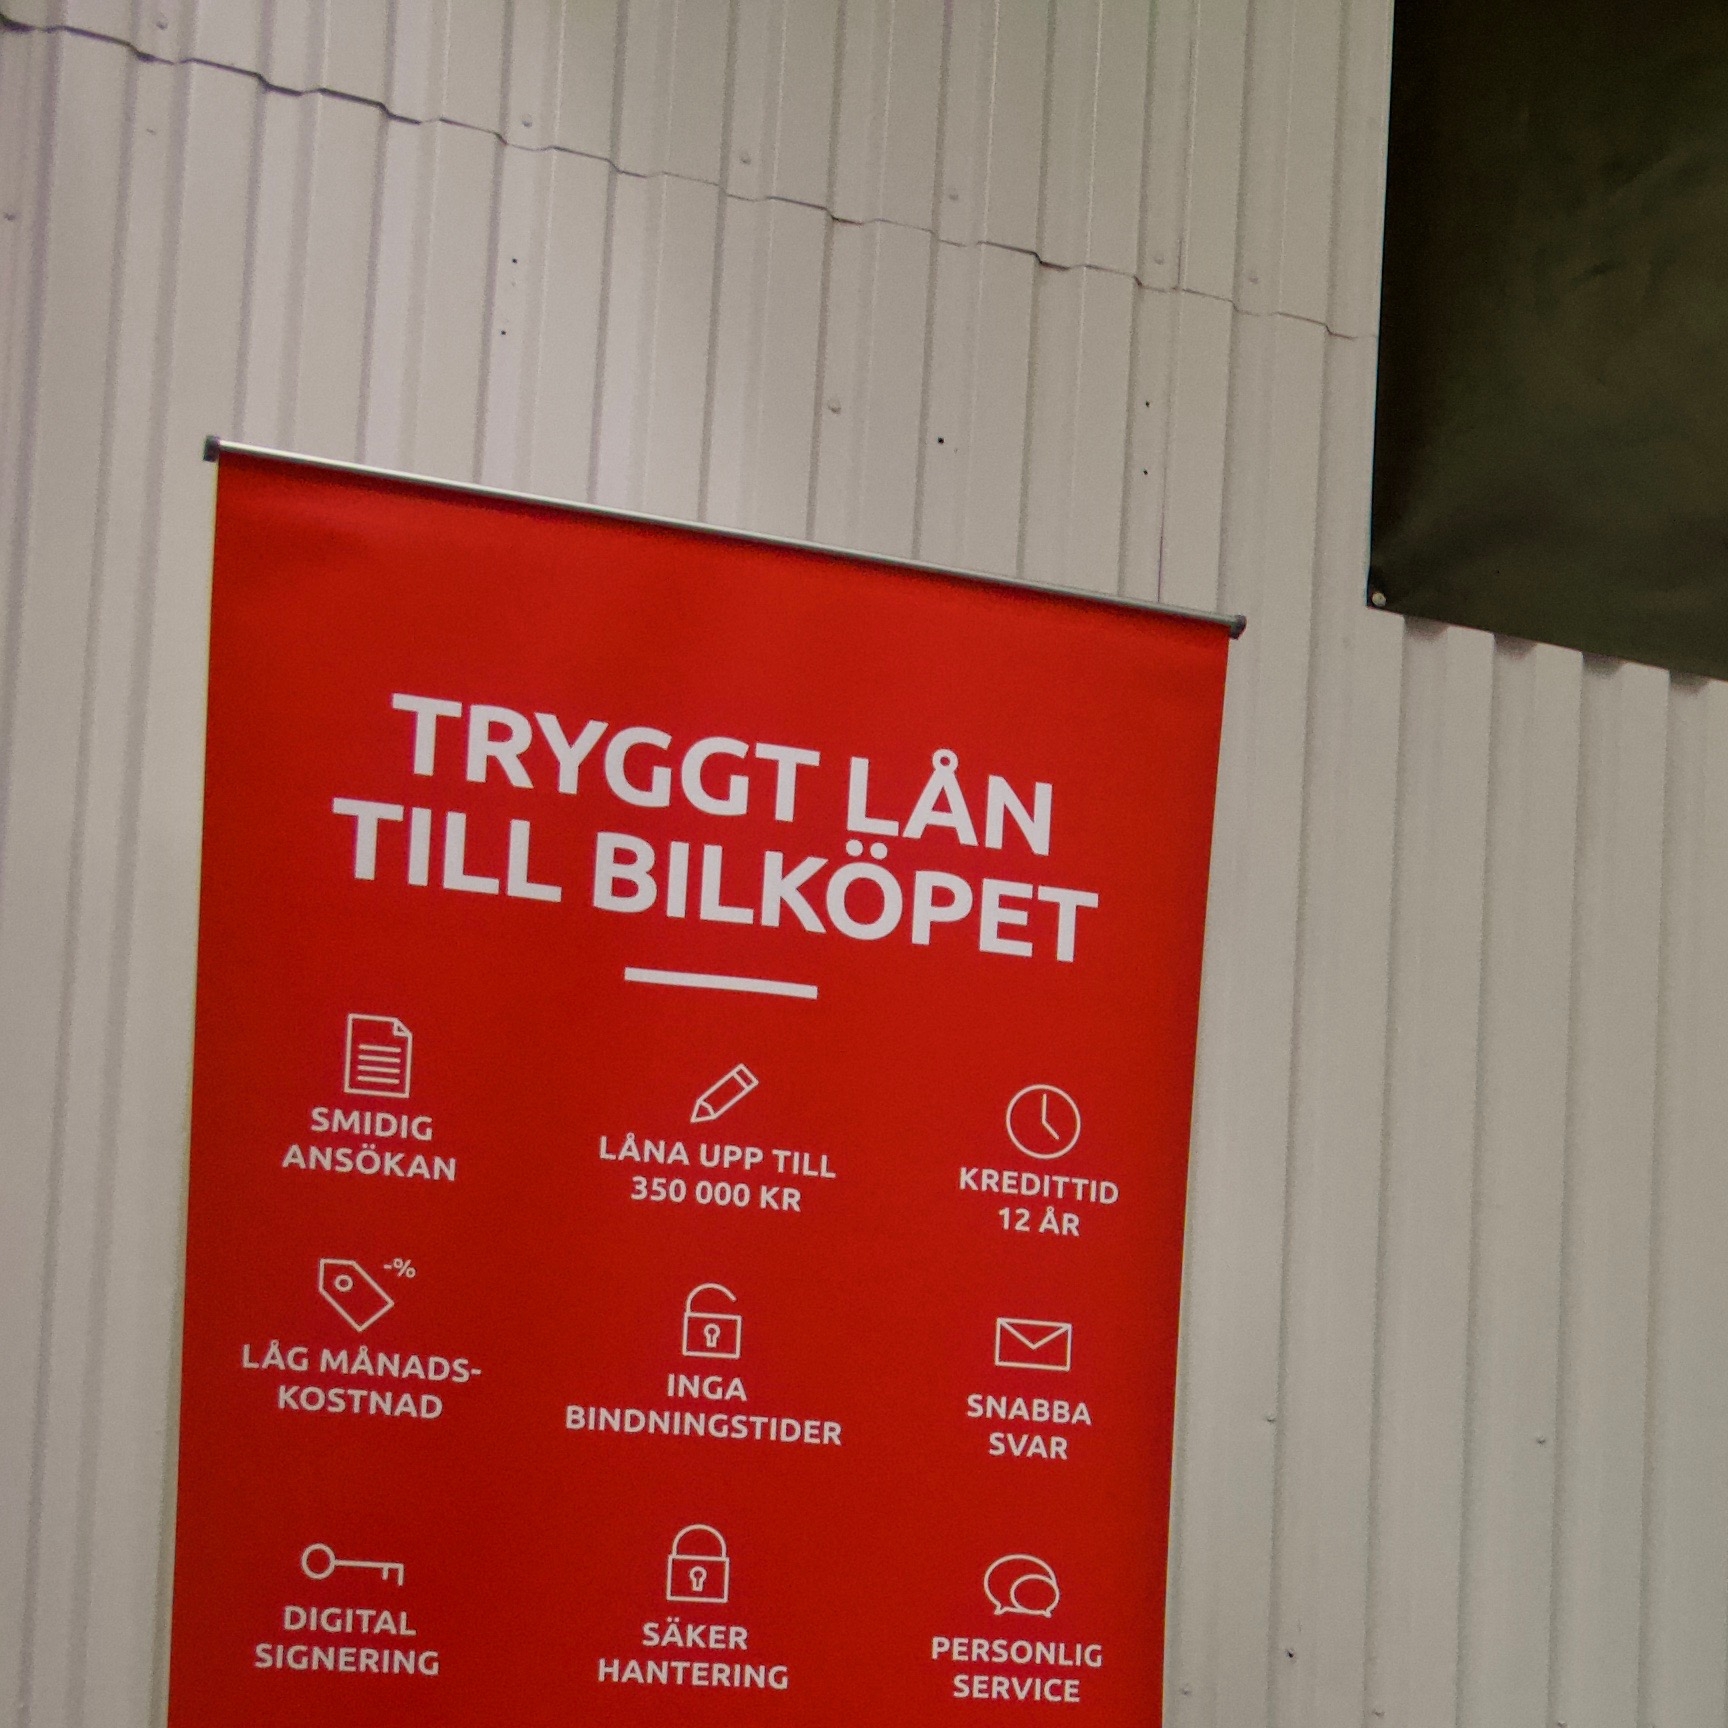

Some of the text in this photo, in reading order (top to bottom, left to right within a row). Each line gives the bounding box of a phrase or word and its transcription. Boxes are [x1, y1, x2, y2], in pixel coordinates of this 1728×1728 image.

[390, 692, 1053, 856] TRYGGT LÅN
[332, 797, 1099, 963] TILL BILKÖPET
[310, 1106, 433, 1142] SMIDIG
[281, 1141, 457, 1184] ANSÖKAN
[599, 1131, 837, 1179] LÅNA UPP TILL
[630, 1175, 801, 1212] 350 000 KR
[959, 1166, 1119, 1205] KREDITTID
[998, 1205, 1080, 1237] 12 ÅR
[242, 1339, 482, 1383] LÅG MÅNADS-
[277, 1384, 443, 1419] KOSTNAD
[667, 1373, 748, 1402] INGA
[565, 1404, 842, 1446] BINDNINGSTIDER
[966, 1393, 1092, 1426] SNABBA
[988, 1431, 1068, 1460] SVAR
[283, 1605, 417, 1636] DIGITAL
[642, 1617, 749, 1650] SÄKER
[254, 1642, 439, 1676] SIGNERING
[931, 1636, 1103, 1668] PERSONLIG
[598, 1657, 789, 1690] HANTERING
[953, 1673, 1081, 1703] SERVICE
